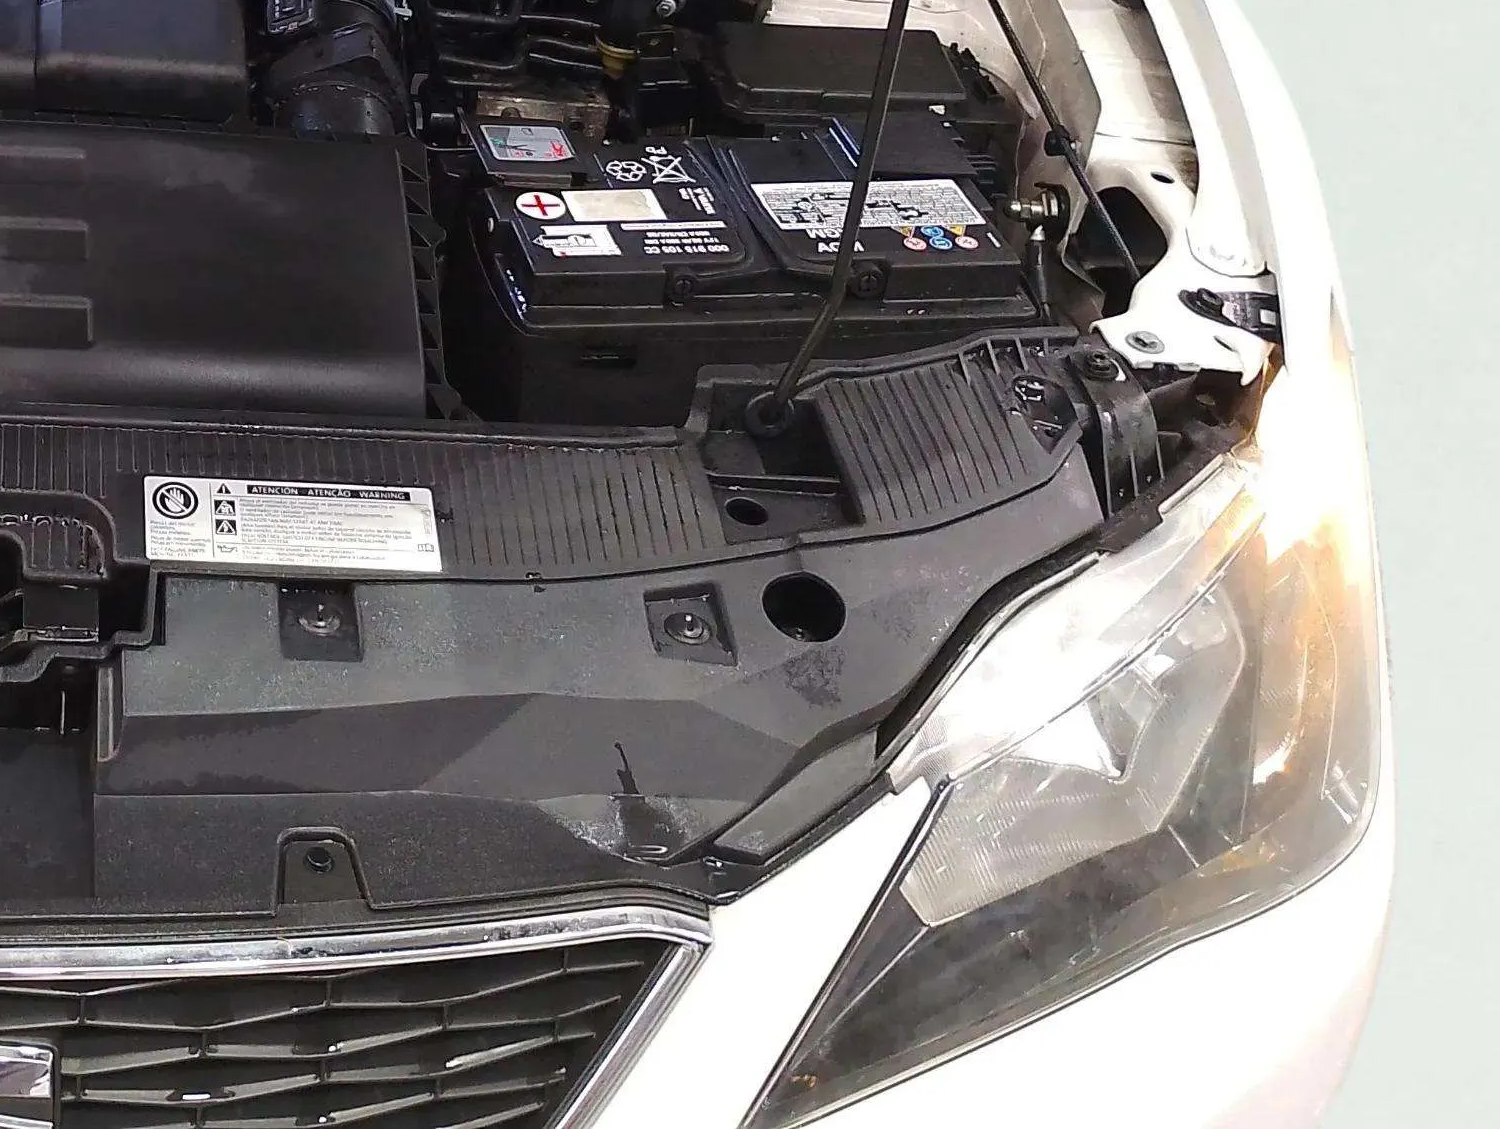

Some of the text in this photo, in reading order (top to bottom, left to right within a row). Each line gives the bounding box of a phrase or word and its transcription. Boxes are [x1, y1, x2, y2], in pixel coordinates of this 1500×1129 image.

[643, 246, 660, 254] CC
[707, 244, 730, 252] 000
[359, 491, 406, 500] WARNING
